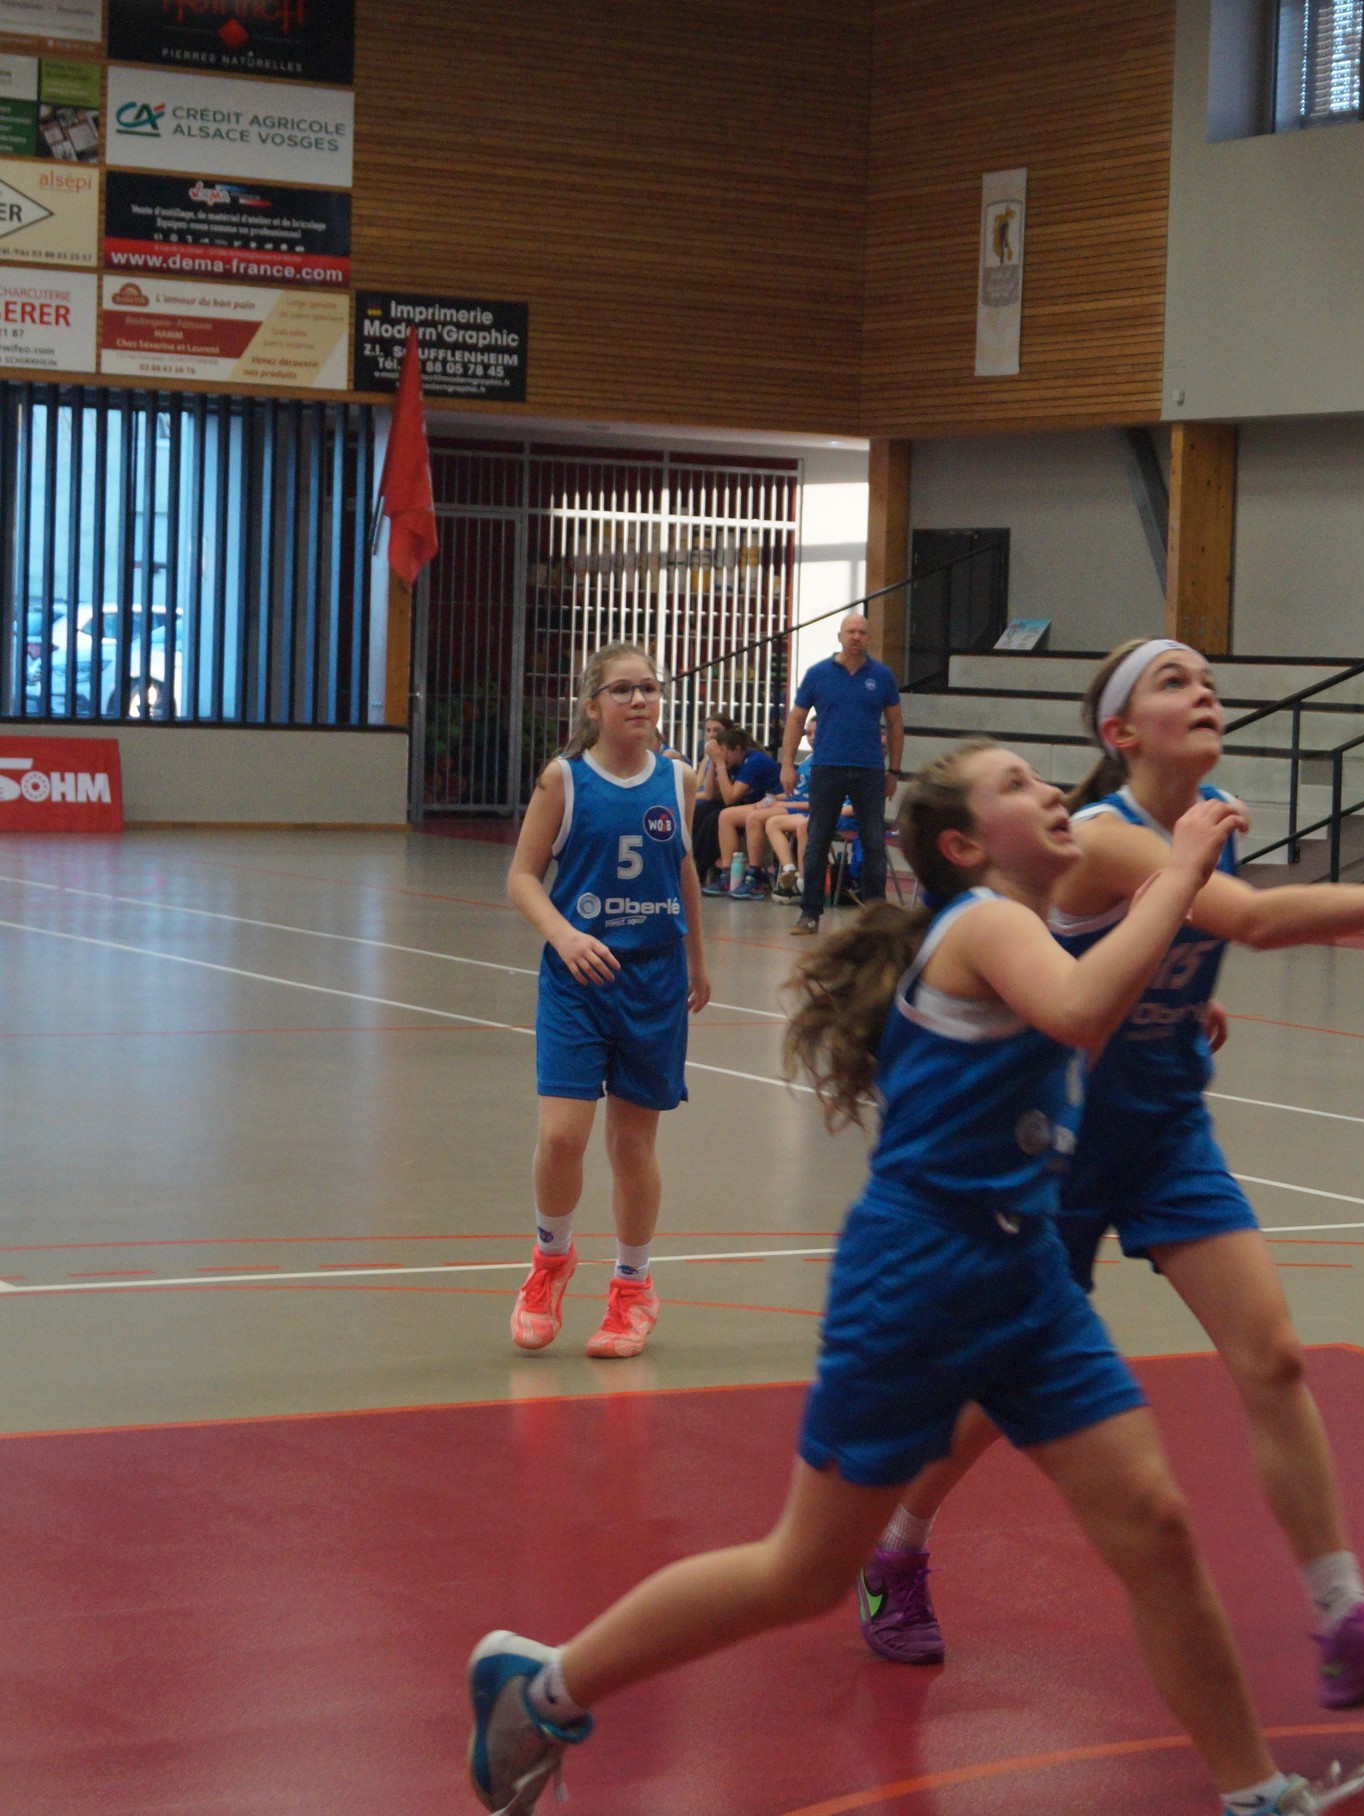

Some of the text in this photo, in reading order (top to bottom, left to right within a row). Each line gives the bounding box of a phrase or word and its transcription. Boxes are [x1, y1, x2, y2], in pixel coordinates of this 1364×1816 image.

[162, 48, 303, 73] PIERRES NATURELLES
[172, 105, 346, 136] CRÉDIT AGRICOLE
[173, 123, 339, 152] ALSACE VOSGES
[111, 251, 343, 282] www.dema-france.com
[0, 300, 71, 327] ERER
[390, 300, 494, 325] Imprimerie
[393, 345, 519, 366] SUFFLENHEIM
[426, 361, 442, 373] 88
[446, 362, 464, 375] 05
[467, 363, 484, 376] 78
[488, 365, 505, 378] 45
[617, 835, 644, 880] 5
[605, 896, 680, 914] Oberlé
